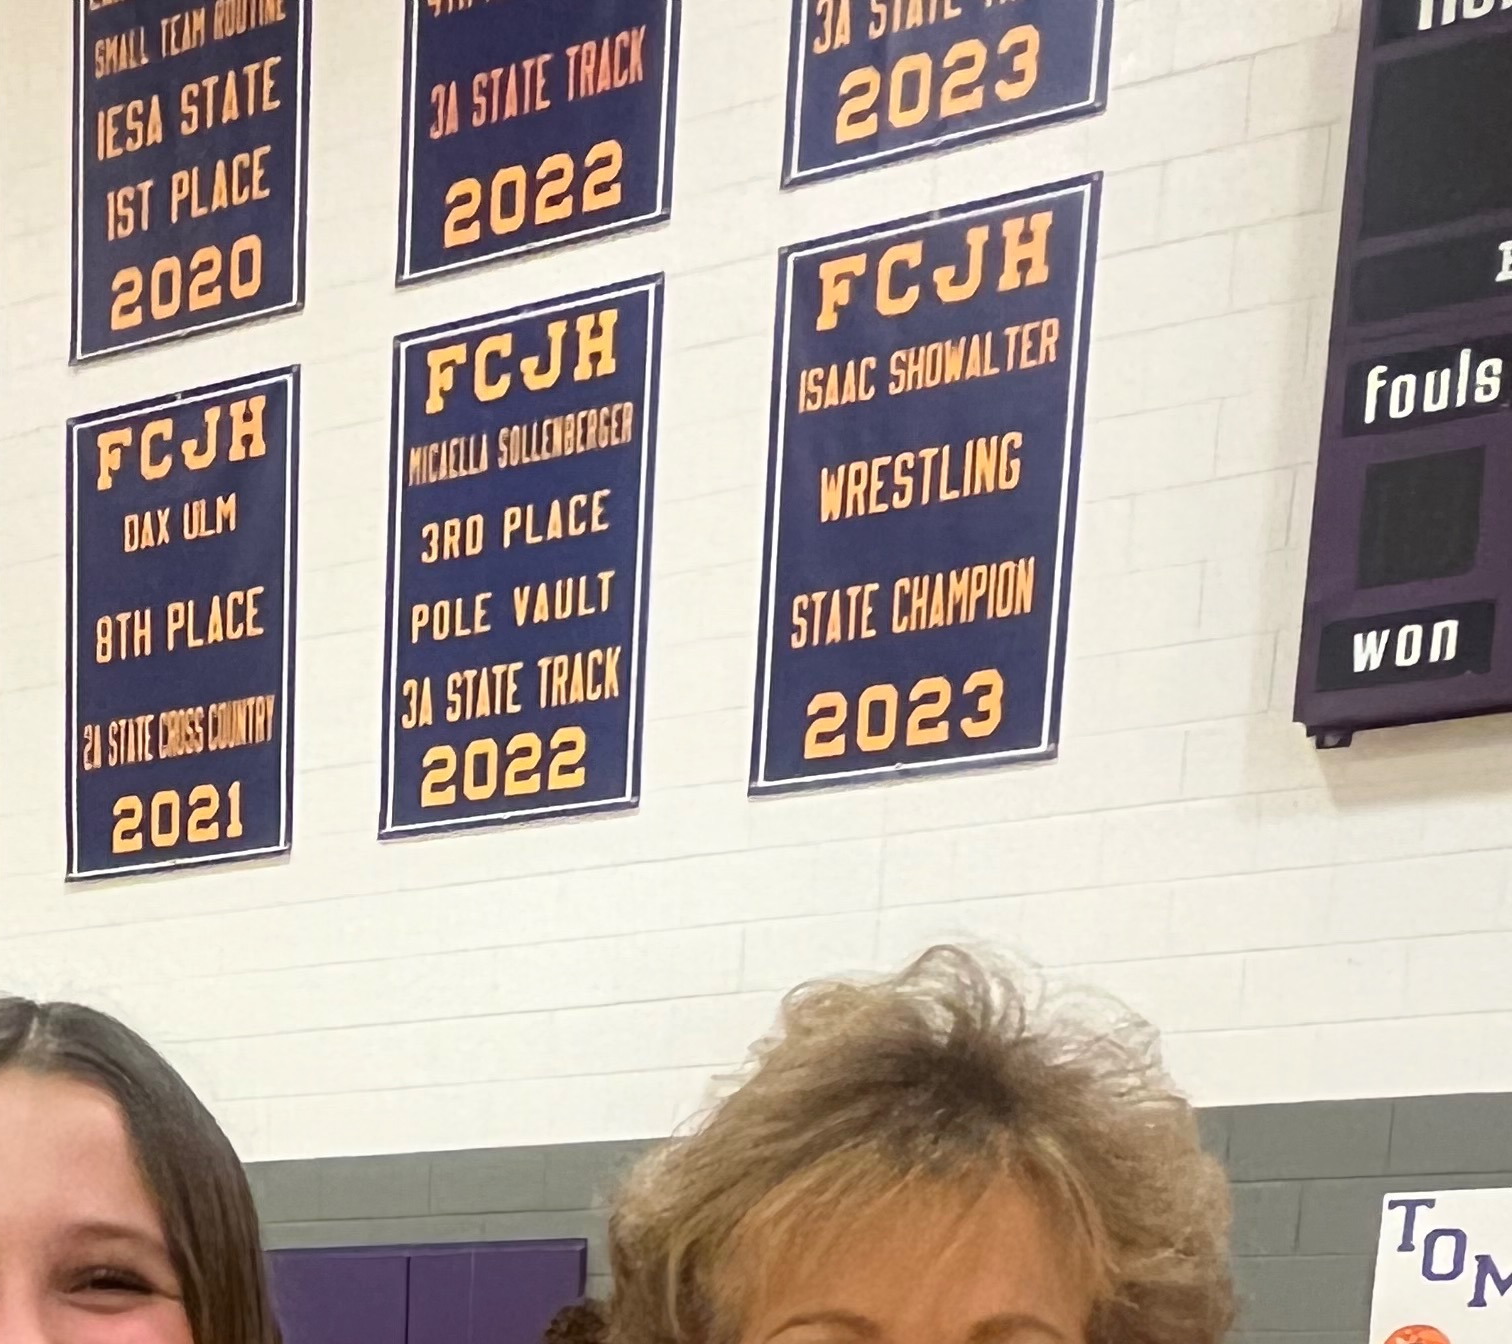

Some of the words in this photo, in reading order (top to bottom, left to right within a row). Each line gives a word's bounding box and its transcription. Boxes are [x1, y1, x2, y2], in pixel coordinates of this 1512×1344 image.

[95, 26, 148, 79] SMALL
[161, 7, 205, 58] TEAM
[429, 80, 459, 139] 3A
[472, 52, 555, 127] STATE
[565, 24, 647, 102] TRACK
[836, 24, 1040, 144] 2023
[97, 94, 163, 161] IESA
[180, 55, 282, 136] STATE
[171, 144, 272, 224] PLACE
[444, 139, 623, 249] 2022
[110, 233, 262, 331] 2020
[816, 211, 1053, 331] FCJH
[425, 308, 619, 415] FCJH
[798, 356, 876, 414] ISAAC
[888, 318, 1060, 398] SHOWALTER
[1364, 348, 1503, 424] fouls
[97, 395, 266, 491] FCJH
[408, 432, 489, 487] MICAELLA
[498, 400, 634, 471] SOLLENBERGER
[820, 431, 1023, 523] WRESTLING
[123, 506, 171, 554] DAX
[182, 492, 237, 541] ULM
[421, 513, 485, 564] 3RD
[504, 489, 612, 549] PLACE
[95, 607, 152, 664] 8TH
[166, 585, 265, 652] PLACE
[411, 591, 493, 645] POLE
[512, 569, 617, 627] VAULT
[791, 582, 880, 650] STATE
[892, 556, 1035, 635] CHAMPION
[1352, 618, 1459, 674] won
[402, 676, 434, 730] 3A
[445, 661, 524, 722] STATE
[537, 645, 622, 709] TRACK
[804, 669, 1004, 759] 2023
[107, 714, 155, 767] STATE
[420, 725, 587, 808] 2022
[112, 780, 244, 854] 2021
